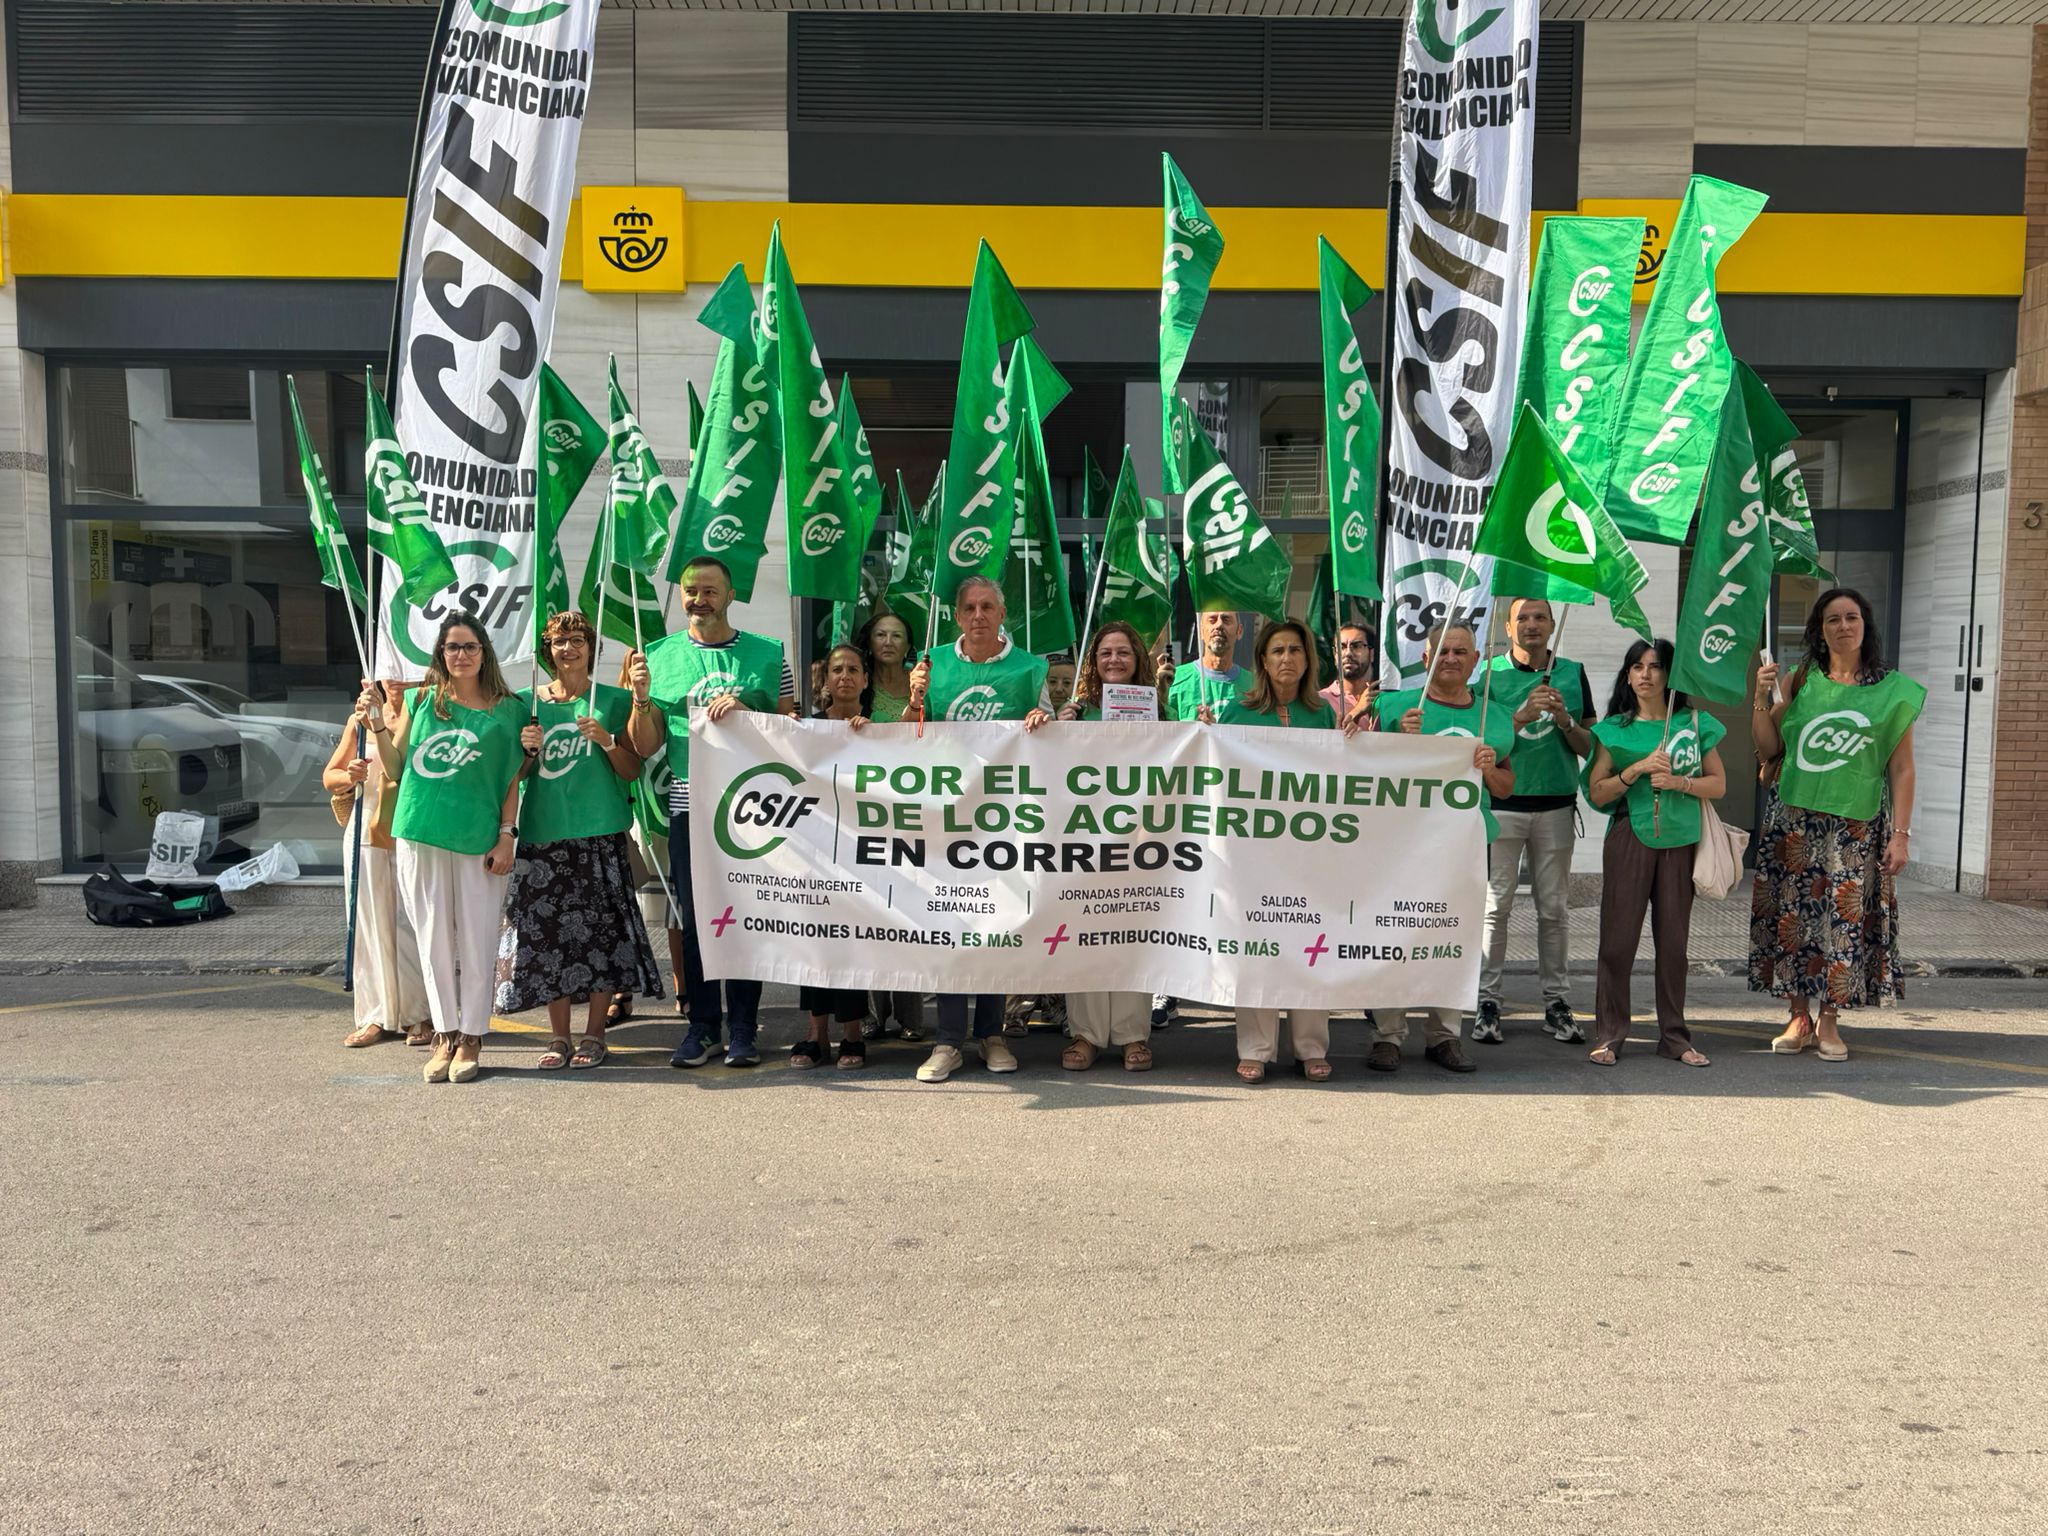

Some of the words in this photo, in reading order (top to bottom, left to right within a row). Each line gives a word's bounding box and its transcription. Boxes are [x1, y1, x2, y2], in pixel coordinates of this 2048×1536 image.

[410, 103, 550, 465] CSIF
[1579, 281, 1614, 301] CSIF
[1397, 141, 1509, 480] CSIF
[547, 426, 582, 451] CSIF
[1641, 474, 1681, 495] CSIF
[2023, 501, 2042, 529] 3
[710, 524, 745, 544] CSIF
[807, 525, 846, 544] CSIF
[1348, 521, 1368, 542] CSIF
[959, 537, 994, 558] CSIF
[1705, 635, 1737, 654] CSIF
[428, 741, 483, 767] CSIF
[545, 735, 588, 761] CSIF
[1807, 727, 1875, 760] CSIF
[855, 764, 964, 796] POR
[983, 765, 1046, 796] EL
[1065, 764, 1480, 810] CUMPLIMIENTO
[733, 791, 820, 829] CSIF
[857, 800, 923, 832] DE
[943, 802, 1045, 834] LOS
[1064, 803, 1360, 844] ACUERDOS
[856, 836, 926, 868] EN
[946, 839, 1203, 873] CORREOS
[728, 871, 806, 890] CONTRATACIÓN
[809, 876, 863, 893] URGENTE
[935, 886, 947, 897] 35
[949, 886, 990, 899] HORAS
[756, 889, 771, 902] DE
[773, 890, 830, 906] PLANTILLA
[1058, 886, 1121, 901] JORNADAS
[1123, 886, 1185, 899] PARCIALES
[1261, 895, 1307, 909] SALIDAS
[926, 900, 996, 914] SEMANALES
[1083, 903, 1091, 915] A
[1093, 900, 1160, 915] COMPLETAS
[1246, 910, 1321, 925] VOLUNTARIAS
[1393, 900, 1447, 914] MAYORES
[1375, 915, 1459, 929] RETRIBUCIONES
[743, 916, 851, 940] CONDICIONES
[855, 926, 957, 950] LABORALES,
[961, 931, 981, 948] ES
[986, 928, 1023, 948] MÁS
[1078, 929, 1212, 955] RETRIBUCIONES,
[1217, 938, 1239, 954] ES
[1244, 937, 1280, 957] MÁS
[1337, 944, 1407, 963] EMPLEO,
[1411, 945, 1429, 961] ES
[1431, 941, 1462, 960] MÁS
